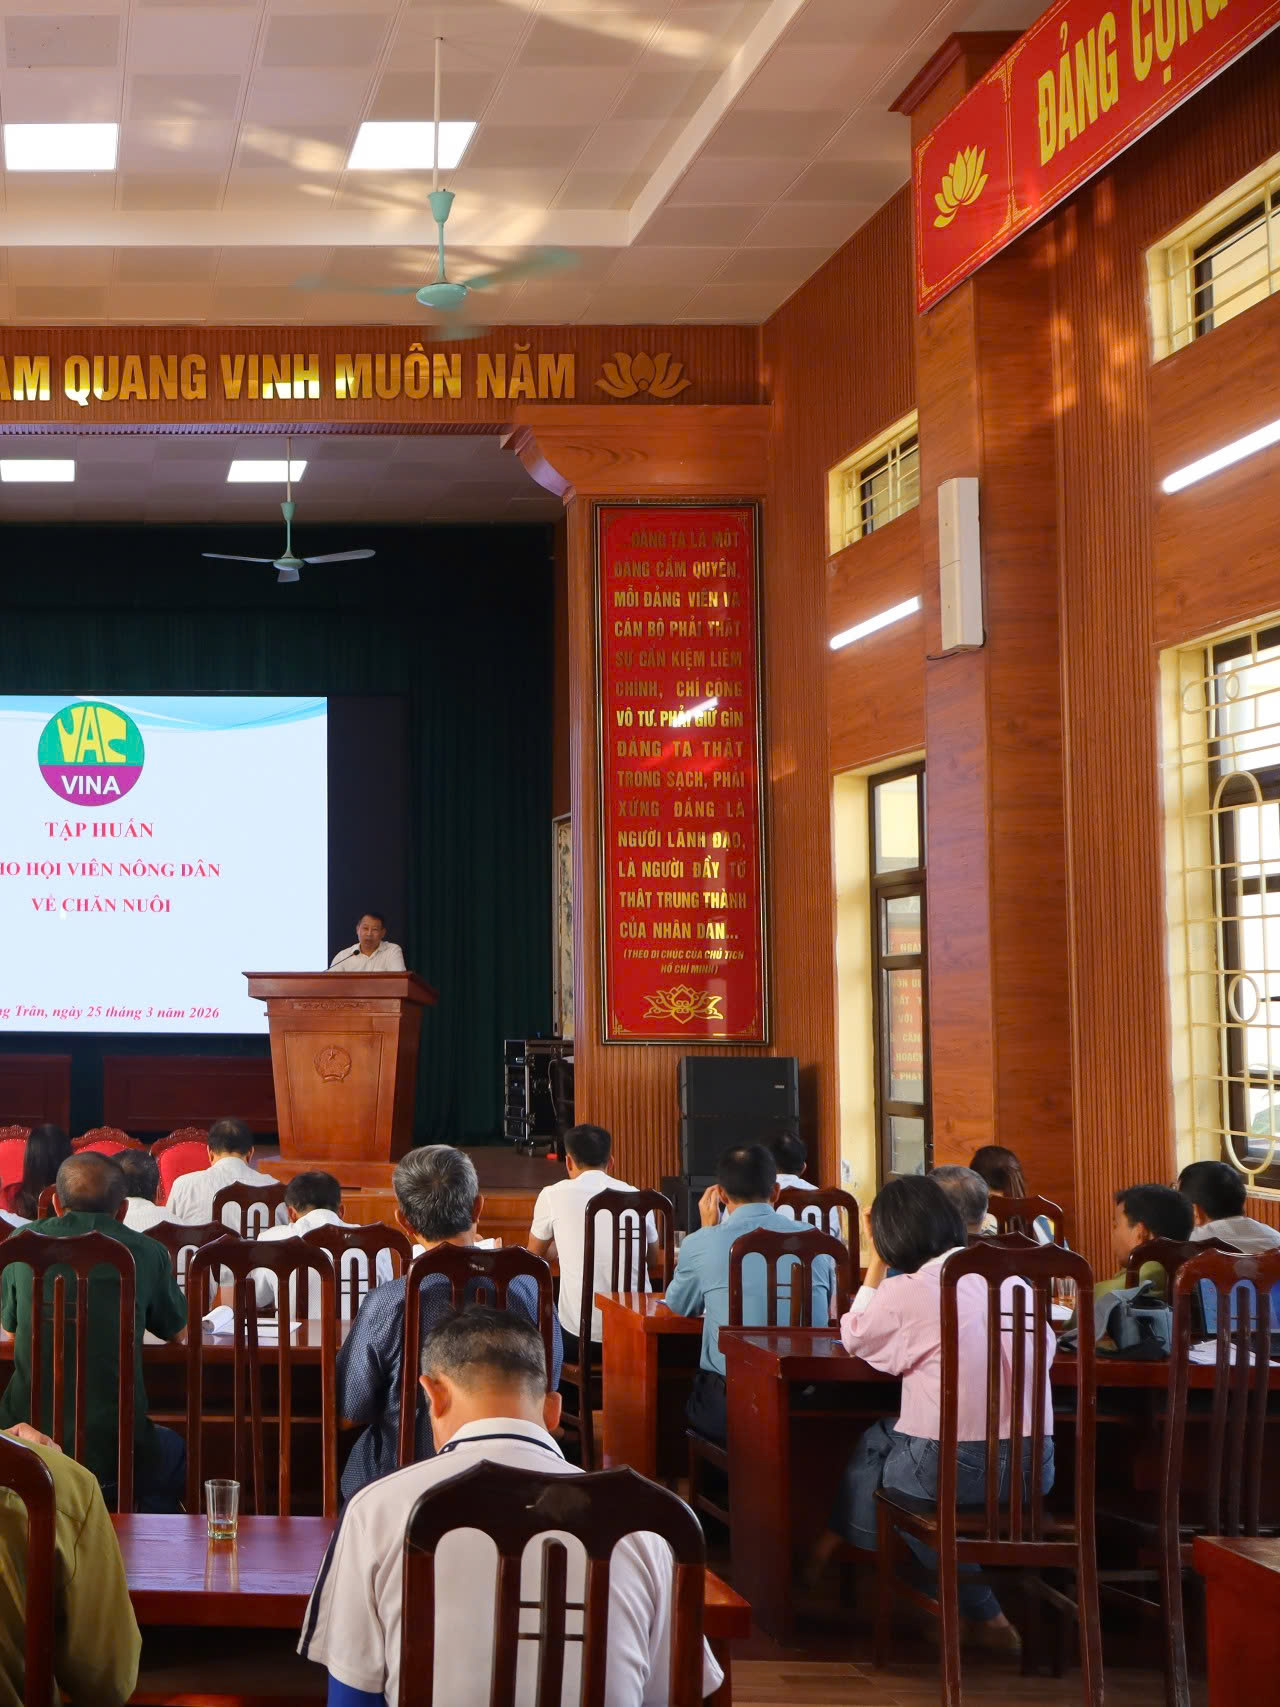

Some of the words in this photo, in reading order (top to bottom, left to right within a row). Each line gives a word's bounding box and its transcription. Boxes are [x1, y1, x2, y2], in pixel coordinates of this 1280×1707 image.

[1038, 11, 1119, 167] ĐẢNG
[63, 354, 207, 407] QUANG
[220, 354, 320, 400] VINH
[336, 343, 463, 399] MUÔN
[475, 343, 575, 399] NĂM
[614, 584, 639, 609] MỖI
[643, 584, 681, 609] ĐẢNG
[688, 587, 719, 609] VIÊN
[615, 617, 642, 638] CÁN
[669, 615, 703, 639] PHẢI
[671, 647, 705, 671] KIỆM
[710, 647, 743, 668] LIÊM
[676, 675, 700, 697] CHÍ
[705, 676, 743, 697] CÔNG
[616, 706, 634, 728] VÔ
[637, 708, 658, 728] TƯ.
[720, 706, 744, 728] GÌN
[57, 706, 127, 763] VAC
[672, 741, 693, 758] TA
[61, 775, 121, 795] VINA
[616, 770, 661, 788] TRONG
[713, 763, 745, 788] PHẢI
[726, 797, 745, 818] LÀ
[44, 819, 87, 841] TẬP
[91, 817, 154, 838] HUẤN
[617, 827, 662, 848] NGƯỜI
[667, 827, 706, 848] LÃNH
[25, 860, 61, 880] HỘI
[66, 858, 113, 877] VIÊN
[118, 858, 175, 878] NÔNG
[181, 859, 221, 878] DÂN
[618, 856, 636, 878] LÀ
[641, 856, 684, 878] NGƯỜI
[31, 893, 57, 912] VỀ
[62, 895, 117, 913] CHĂN
[122, 894, 171, 913] NUÔI
[656, 891, 700, 909] TRUNG
[702, 887, 747, 909] THÀNH
[619, 915, 647, 940] CỦA
[652, 919, 692, 940] NHÂN
[52, 1005, 83, 1020] ngày
[86, 1006, 103, 1018] 25
[105, 1006, 142, 1021] tháng
[145, 1006, 153, 1018] 3
[157, 1007, 185, 1019] năm
[189, 1007, 220, 1019] 2026
